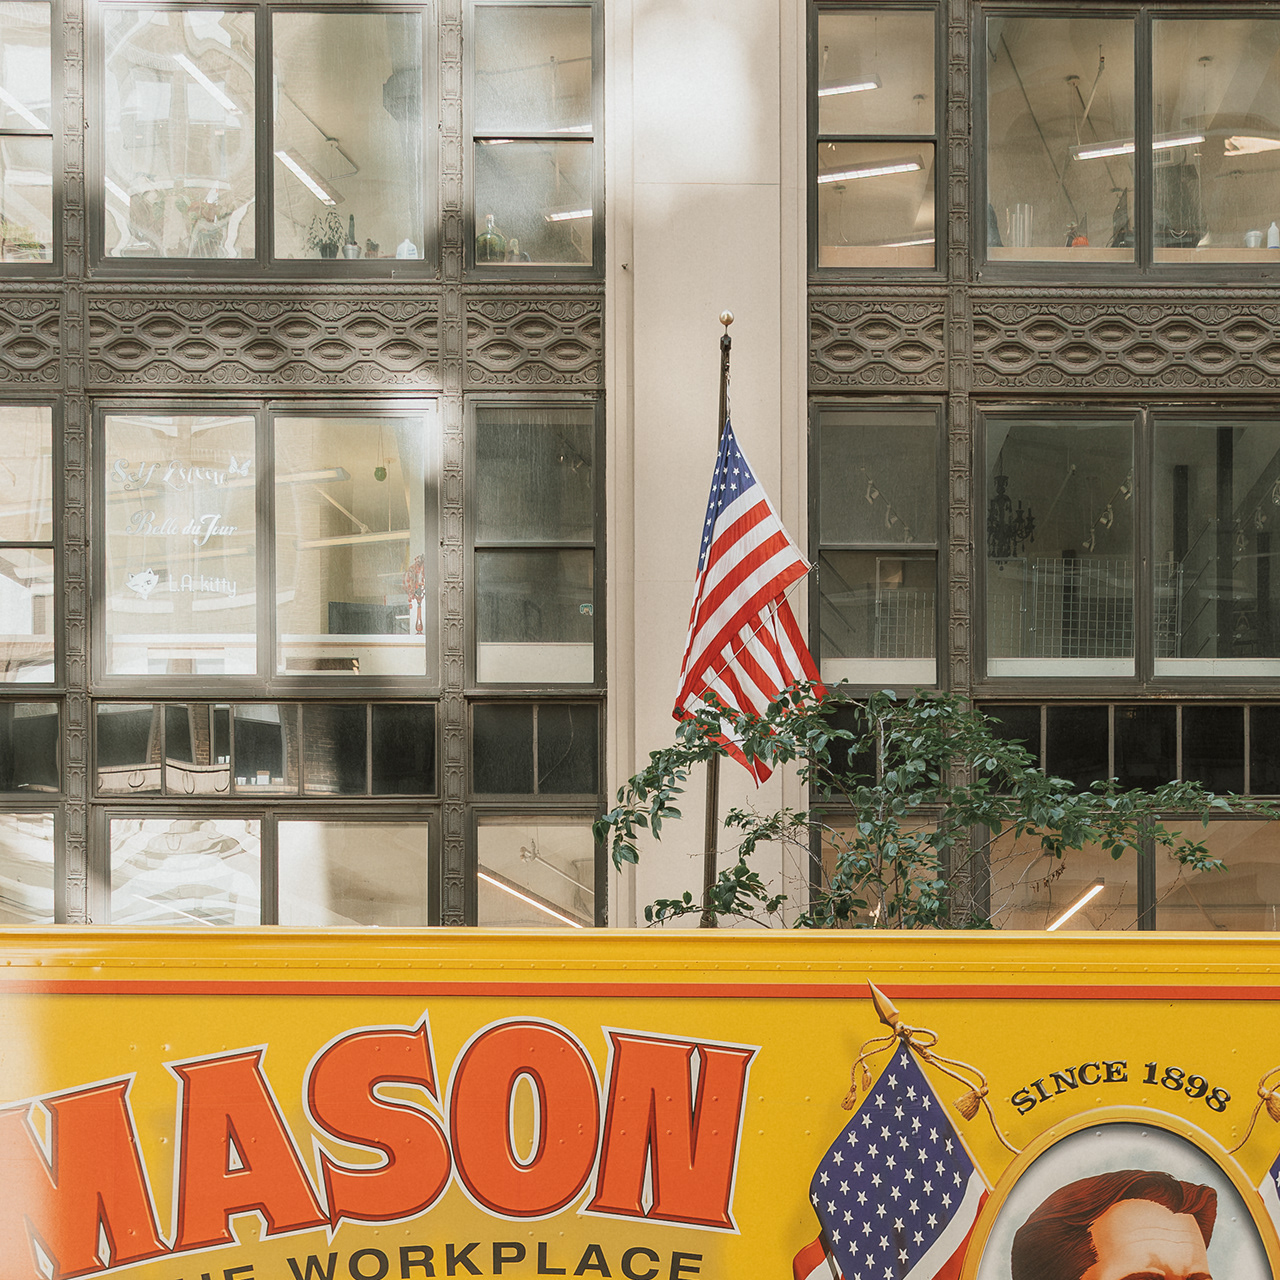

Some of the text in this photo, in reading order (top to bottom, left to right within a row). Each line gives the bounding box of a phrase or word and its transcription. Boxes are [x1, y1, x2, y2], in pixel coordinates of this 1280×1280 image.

[126, 509, 237, 546] Belle du Jour
[169, 574, 237, 598] L.A. kitty
[1010, 1060, 1234, 1117] SINCE 1898
